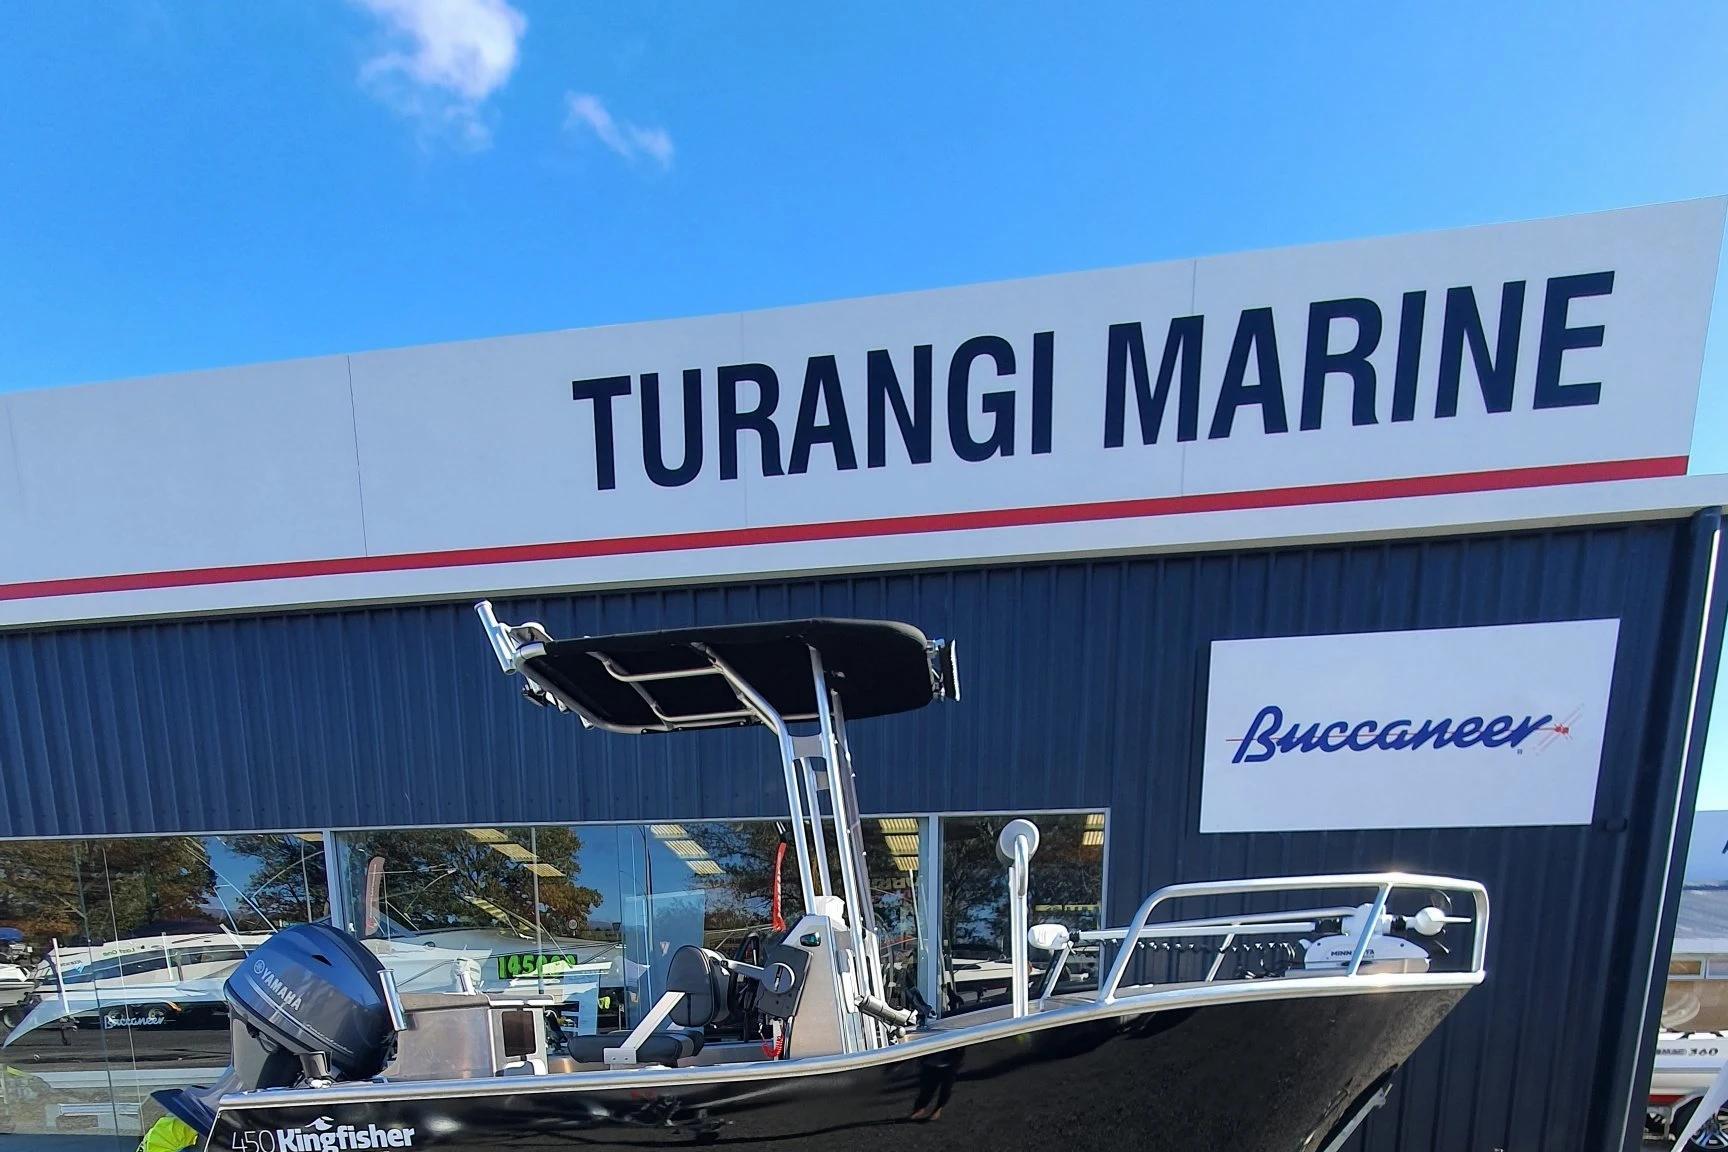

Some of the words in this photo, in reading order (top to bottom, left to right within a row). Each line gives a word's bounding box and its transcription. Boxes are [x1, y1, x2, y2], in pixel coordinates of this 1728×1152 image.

[572, 330, 1055, 491] TURANGI
[1104, 270, 1616, 449] MARINE
[1231, 705, 1552, 764] Buccaneer
[261, 967, 302, 1010] YAMAHA
